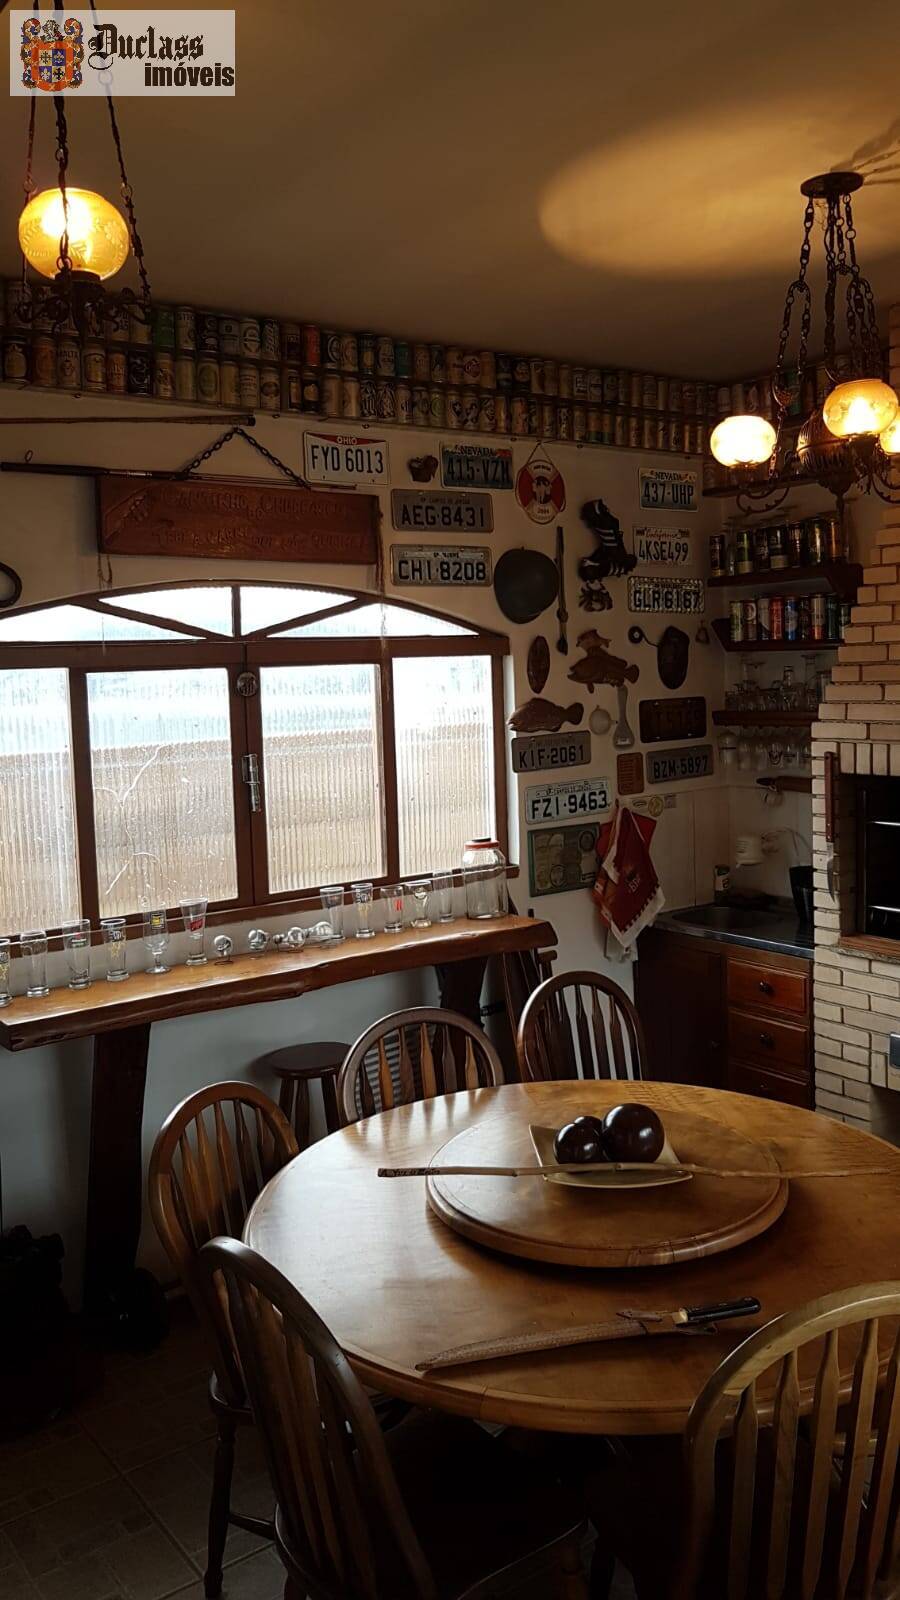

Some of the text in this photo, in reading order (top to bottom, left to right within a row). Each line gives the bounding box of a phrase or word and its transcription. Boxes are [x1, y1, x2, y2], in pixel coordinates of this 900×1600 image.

[336, 436, 359, 445] OHIO
[344, 448, 384, 474] 6013
[655, 471, 682, 481] NEVADA
[639, 540, 689, 562] 4KSE499
